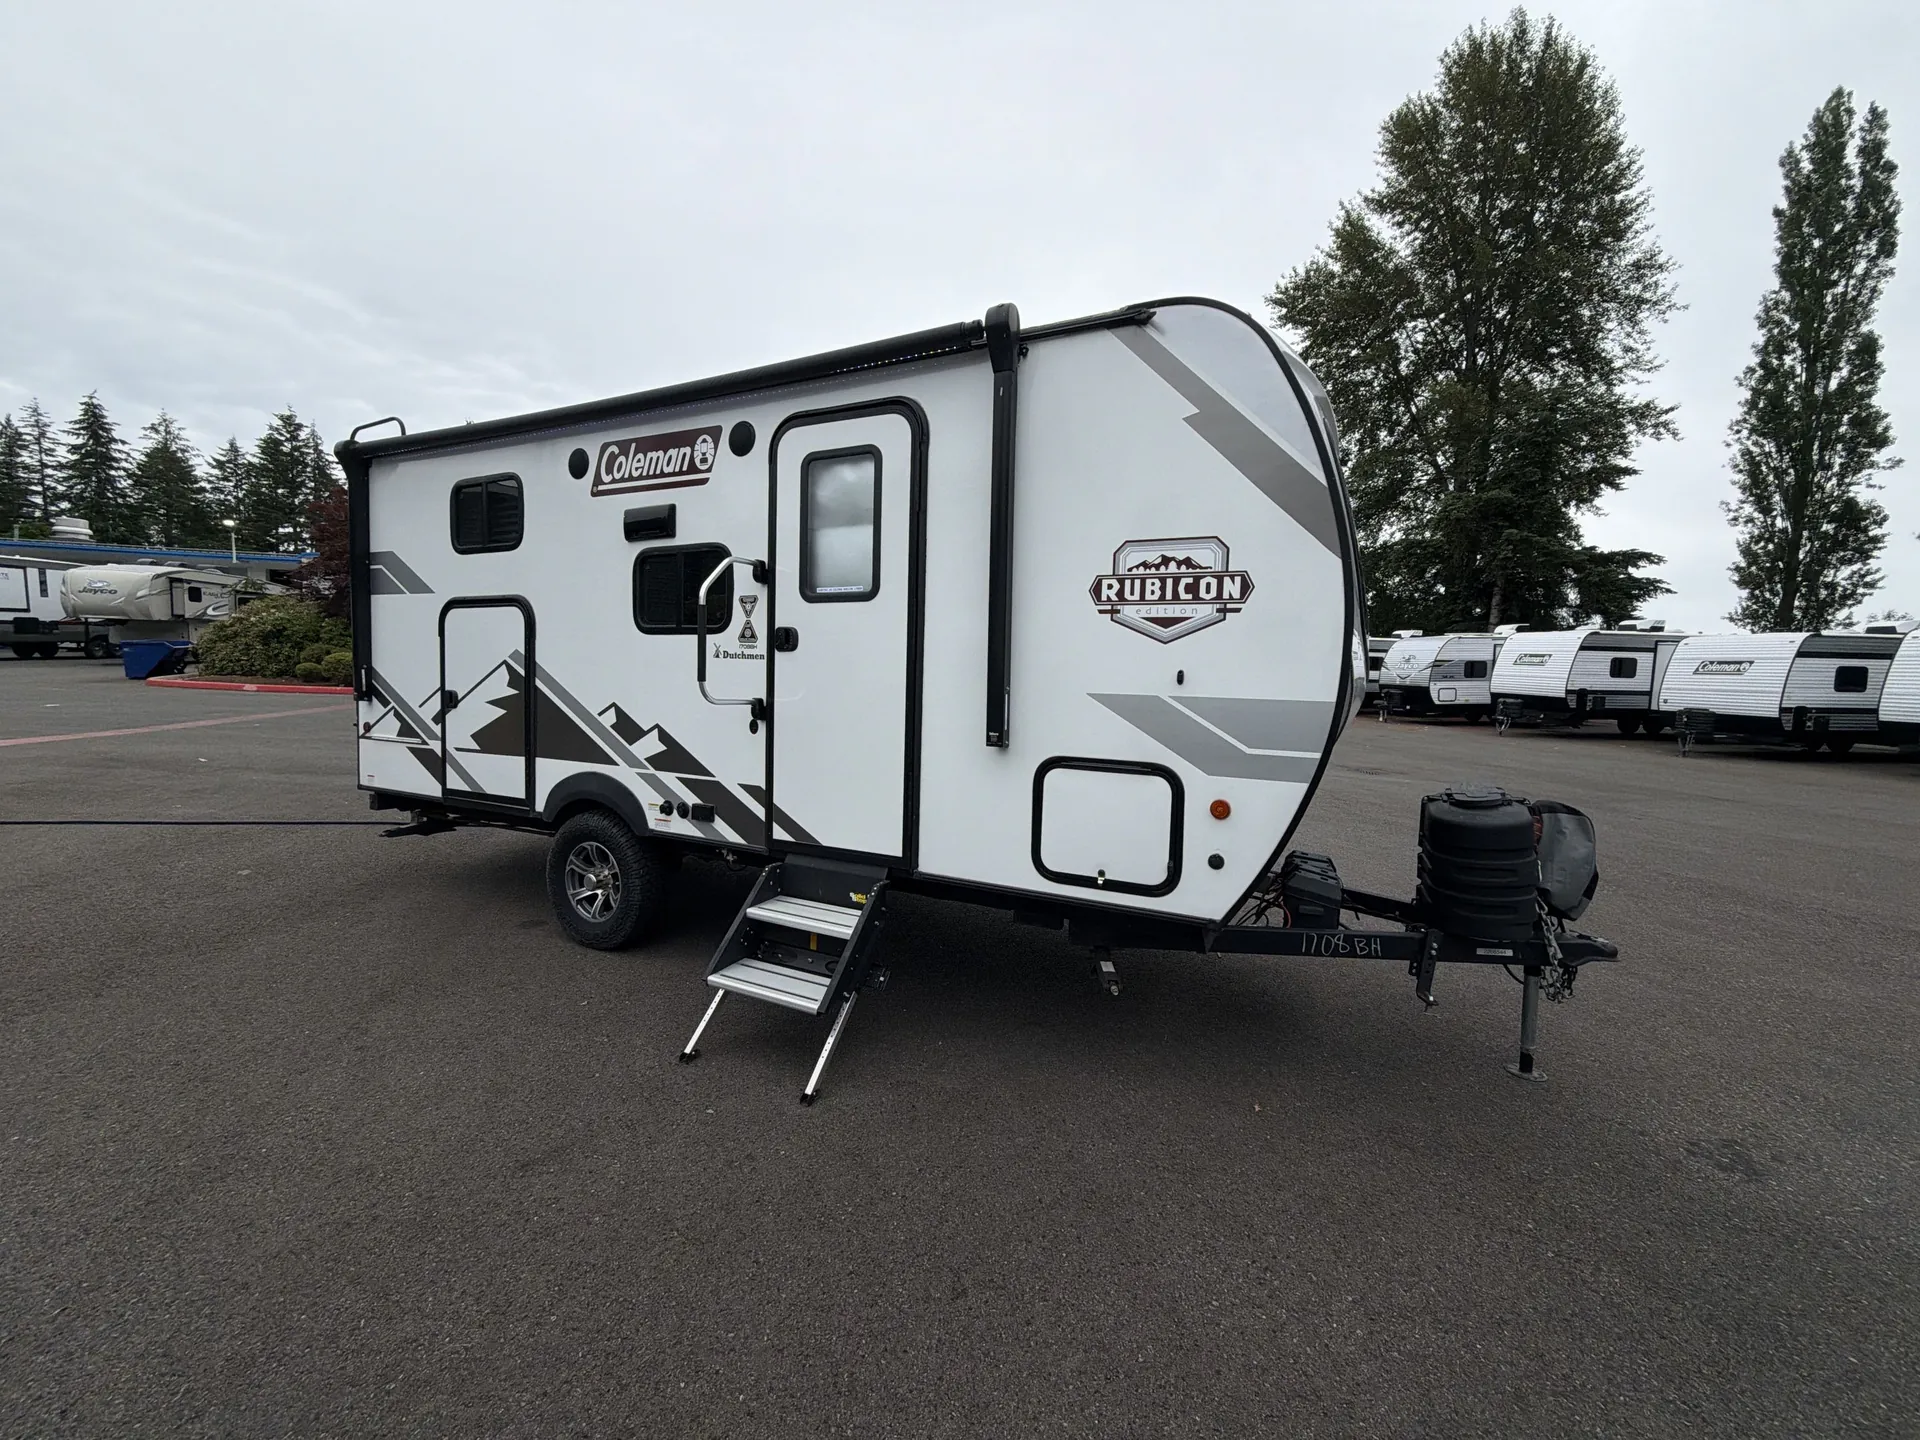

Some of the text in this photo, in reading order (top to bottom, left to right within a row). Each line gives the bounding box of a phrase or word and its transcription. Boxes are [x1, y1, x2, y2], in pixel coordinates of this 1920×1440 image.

[600, 443, 692, 483] Coleman
[78, 587, 118, 595] Jayco
[1101, 575, 1242, 602] RUBICON
[1135, 606, 1199, 615] edition
[722, 650, 765, 660] Dutchmen
[1516, 654, 1545, 663] Coleman
[1395, 662, 1419, 670] Jayco
[1698, 661, 1741, 671] Coleman
